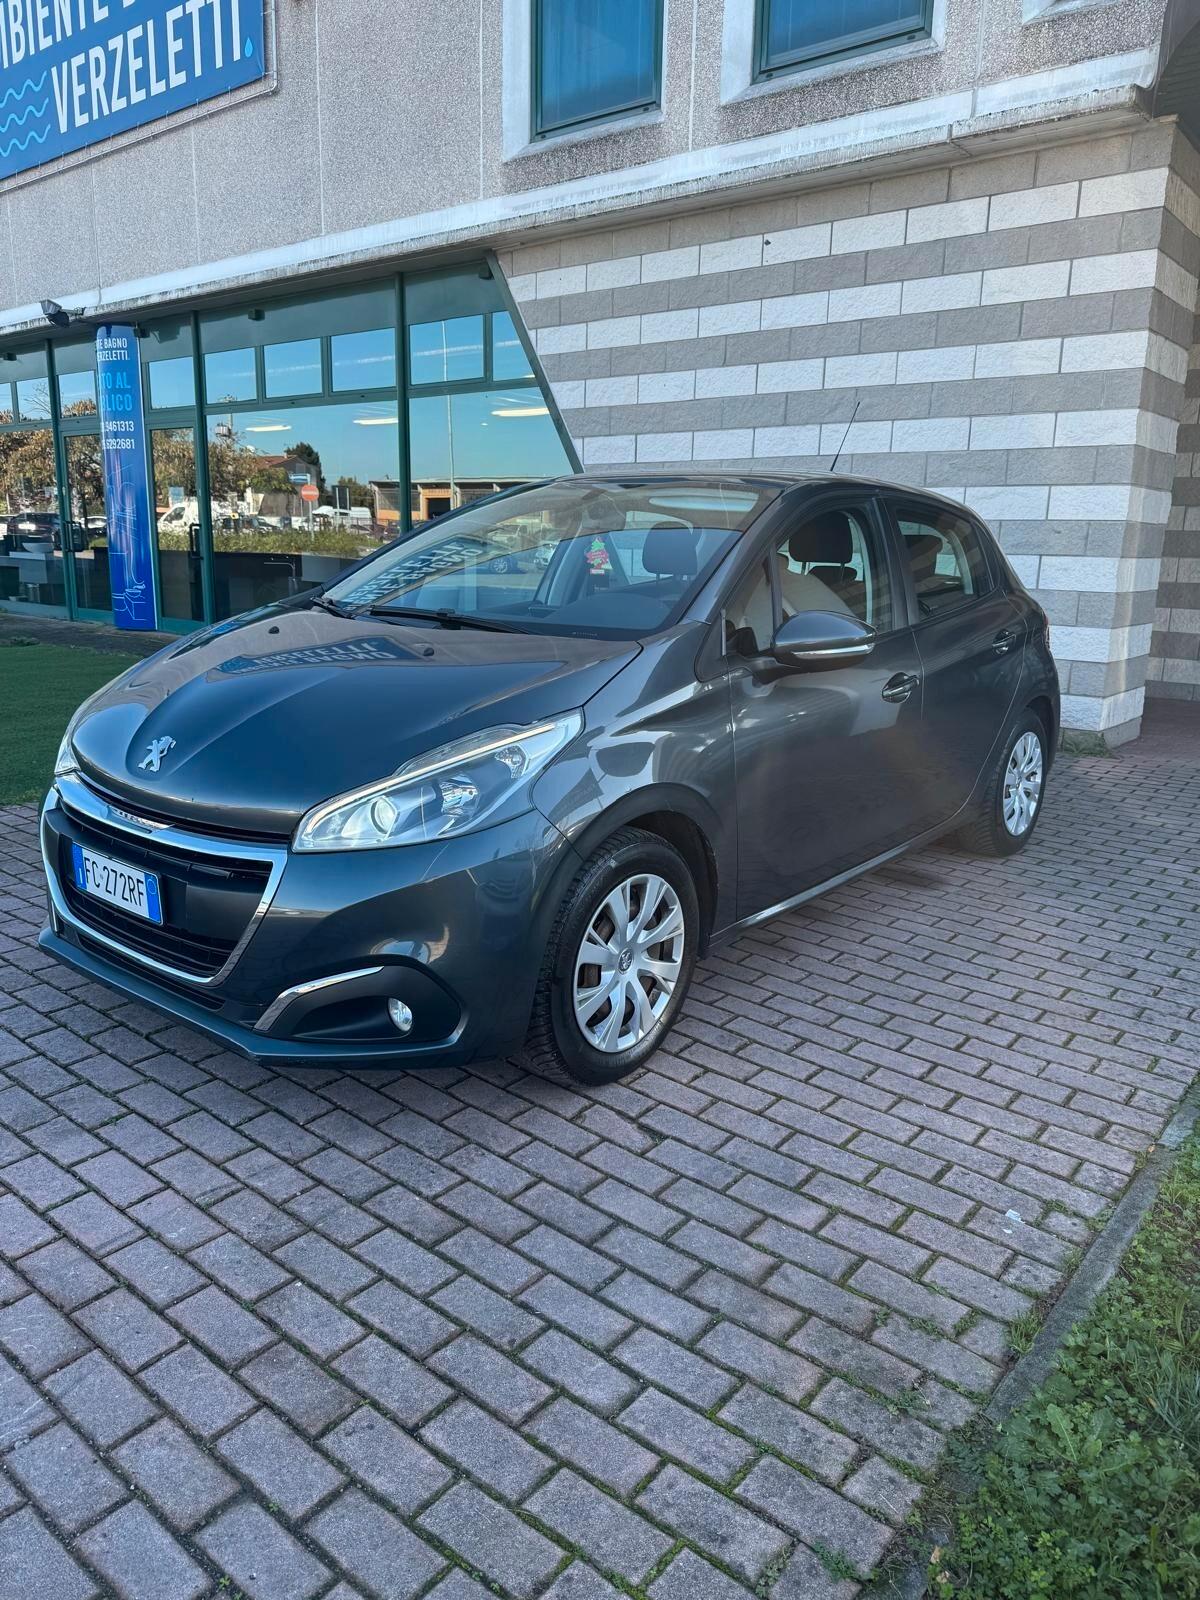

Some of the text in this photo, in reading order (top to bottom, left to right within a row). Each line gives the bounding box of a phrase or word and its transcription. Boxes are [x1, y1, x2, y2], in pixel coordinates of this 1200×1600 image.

[51, 0, 241, 134] VERZELETTI
[104, 338, 128, 349] BAGNO
[115, 371, 131, 389] AL
